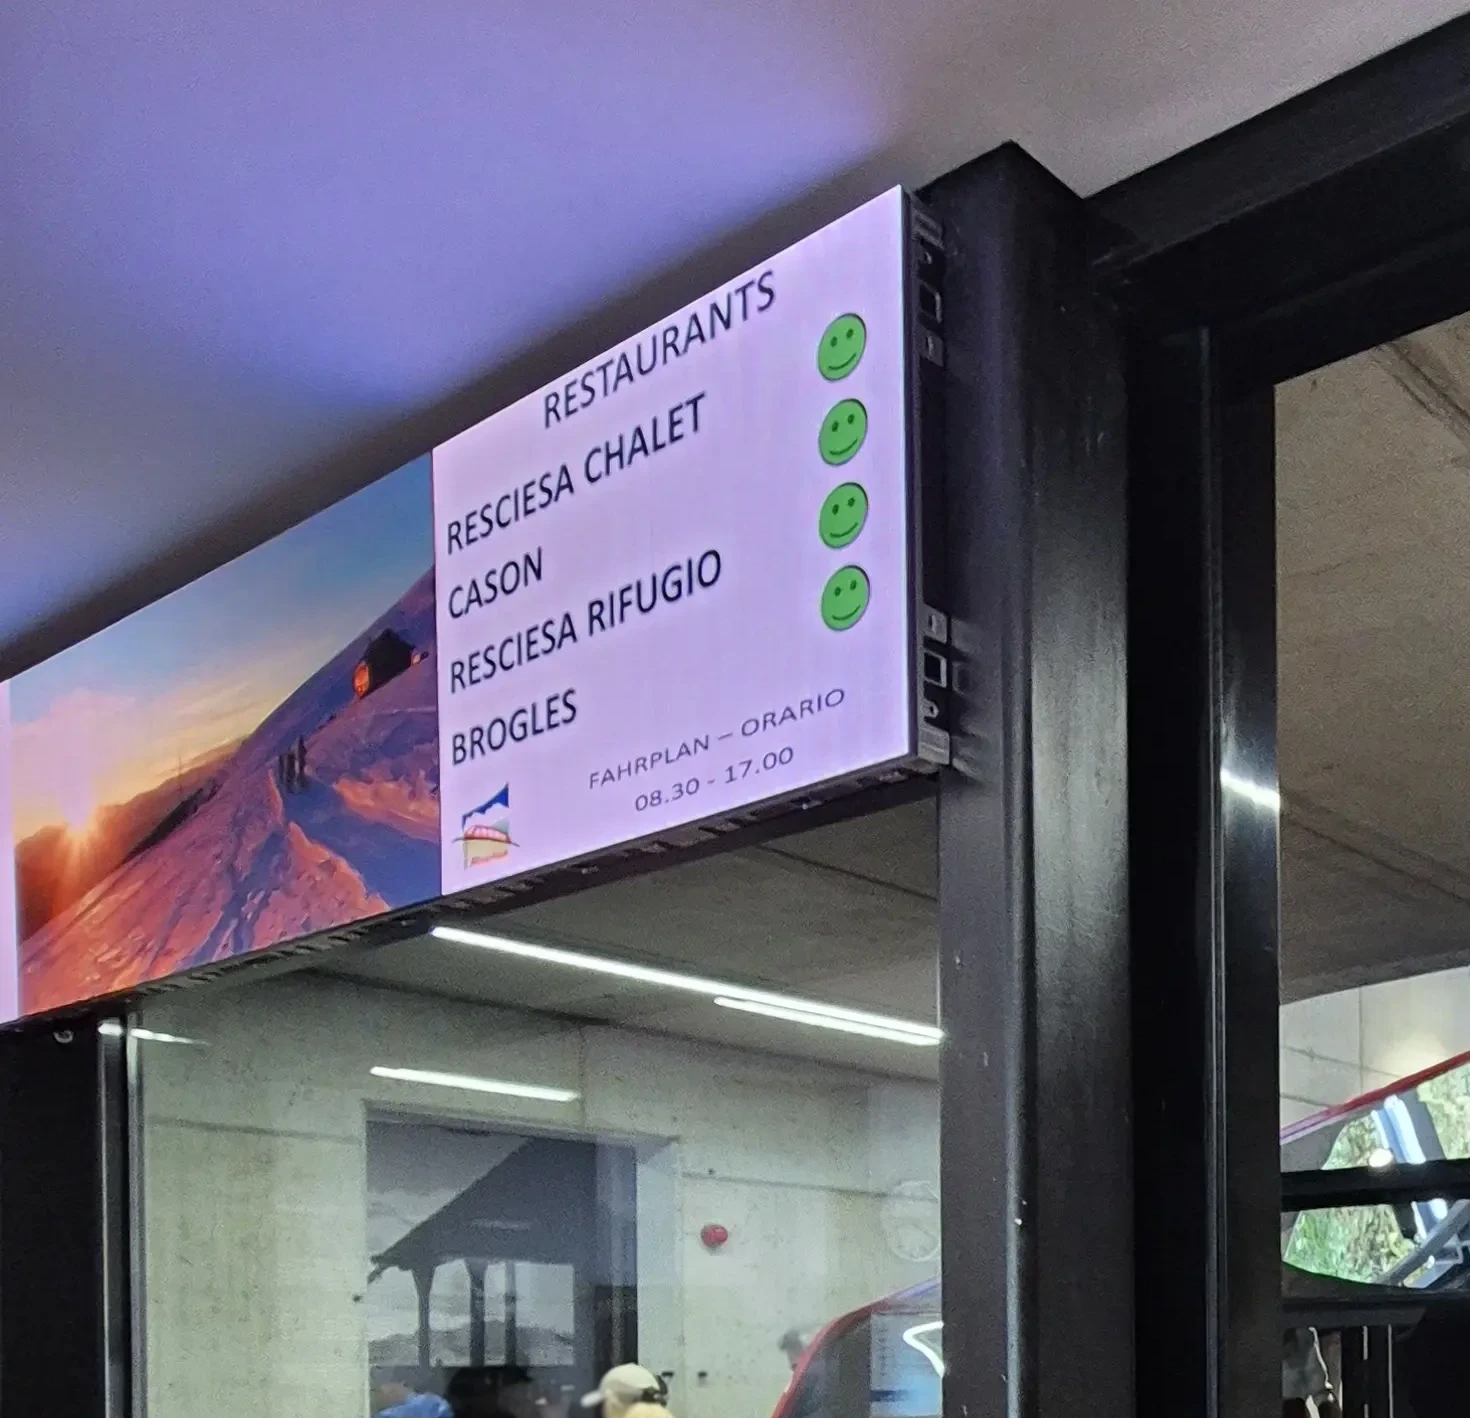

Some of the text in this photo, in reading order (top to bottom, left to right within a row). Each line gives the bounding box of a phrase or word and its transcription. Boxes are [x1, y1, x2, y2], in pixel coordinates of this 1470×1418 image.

[544, 271, 777, 429] RESTAURANTS
[447, 392, 708, 556] RESCIESA CHALET
[448, 547, 544, 620] CASON
[450, 549, 721, 694] RESCIESA RIFUGIO
[452, 688, 578, 766] BROGLES
[588, 733, 710, 790] FAHRPLAN
[741, 688, 845, 737] ORARIO
[634, 776, 701, 813] 08.30
[723, 746, 794, 784] 17.00
